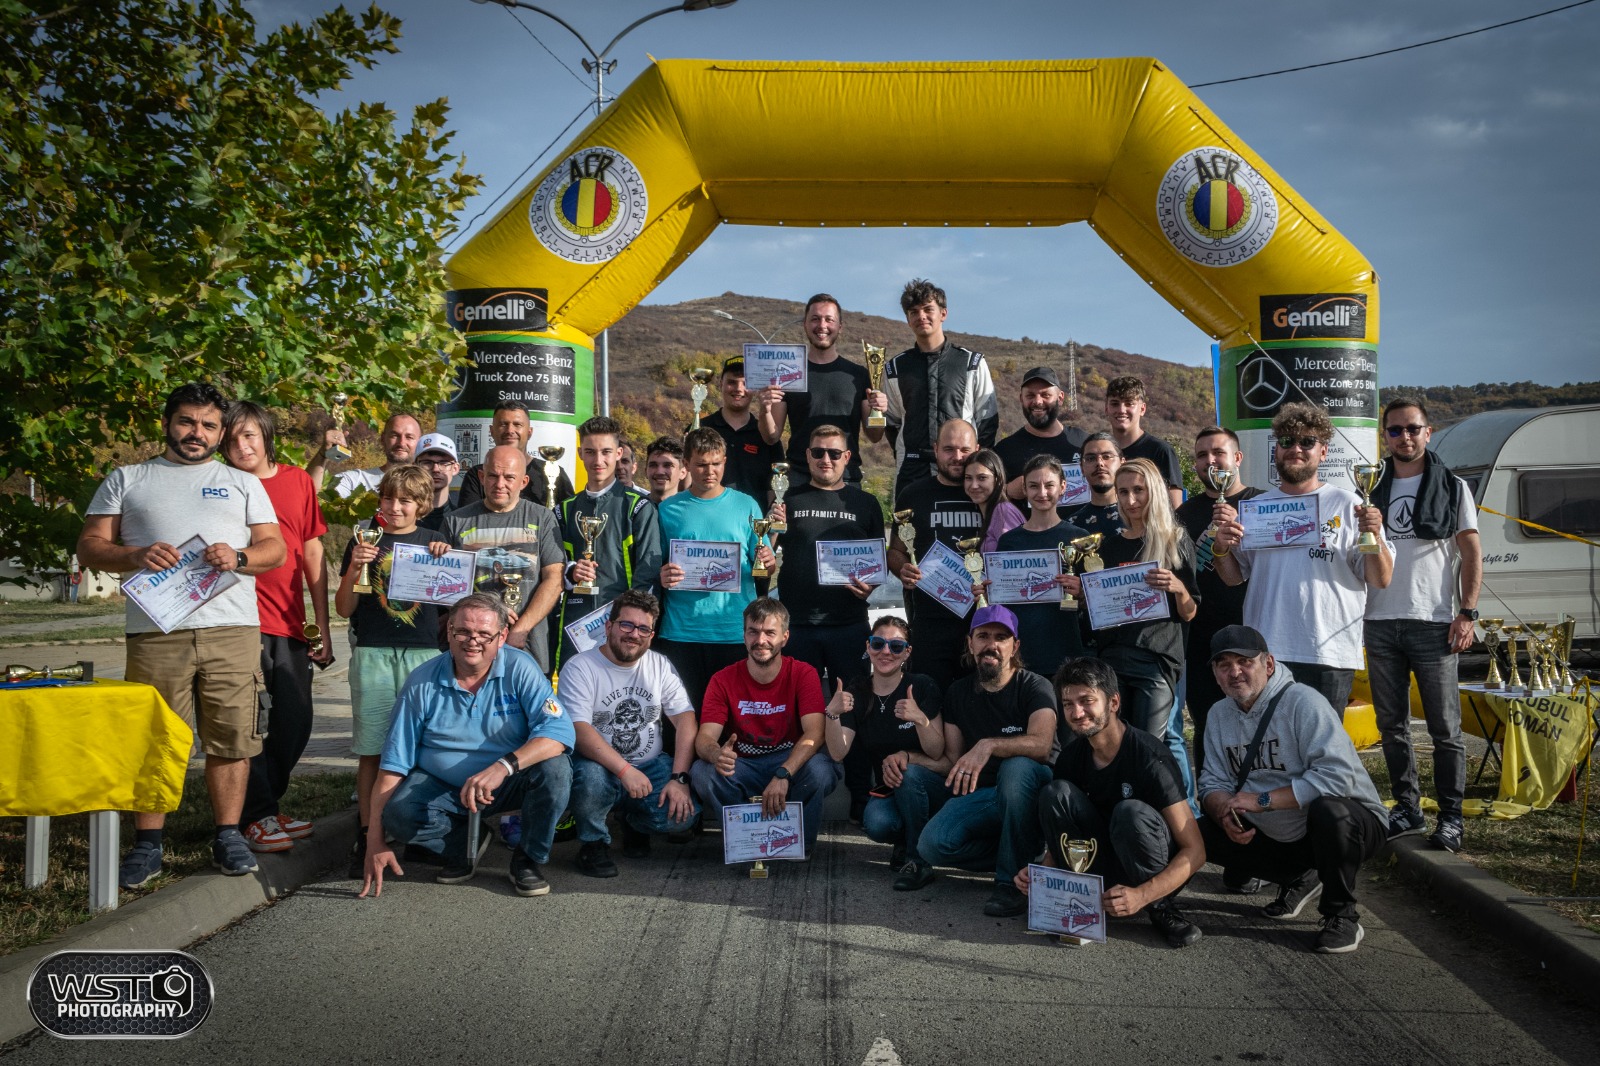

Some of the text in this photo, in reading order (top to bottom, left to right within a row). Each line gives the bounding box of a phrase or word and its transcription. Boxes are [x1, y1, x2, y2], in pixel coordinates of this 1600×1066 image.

[570, 154, 614, 182] ACR
[1194, 154, 1241, 184] ACR
[1164, 165, 1192, 250] AUTOMOBIL
[1206, 231, 1266, 260] CLUBUL
[573, 231, 631, 257] CLUBUL
[758, 350, 796, 360] DIPLOMA
[475, 372, 571, 386] Truck Zone 75 BNK
[1297, 378, 1326, 389] Truck
[1330, 378, 1353, 389] Zone
[1354, 379, 1364, 390] 75
[498, 391, 549, 402] Satu Mare
[1323, 397, 1364, 408] Satu Mare
[1257, 502, 1306, 515] DIPLOMA
[794, 510, 857, 522] BEST FAMILY EVER
[930, 511, 983, 528] PUMA
[687, 547, 729, 558] DIPLOMA
[833, 546, 873, 556] DIPLOMA
[1308, 548, 1335, 562] GOOFY
[1503, 553, 1520, 563] 516
[413, 553, 462, 569] DIPLOMA
[1003, 558, 1048, 569] DIPLOMA
[148, 550, 199, 587] DIPLOMA
[1101, 572, 1146, 589] DIPLOMA
[585, 612, 611, 633] DIPLO
[601, 689, 622, 707] LIVE
[740, 704, 786, 716] FURIOUS
[1046, 876, 1090, 896] DIPLOMA
